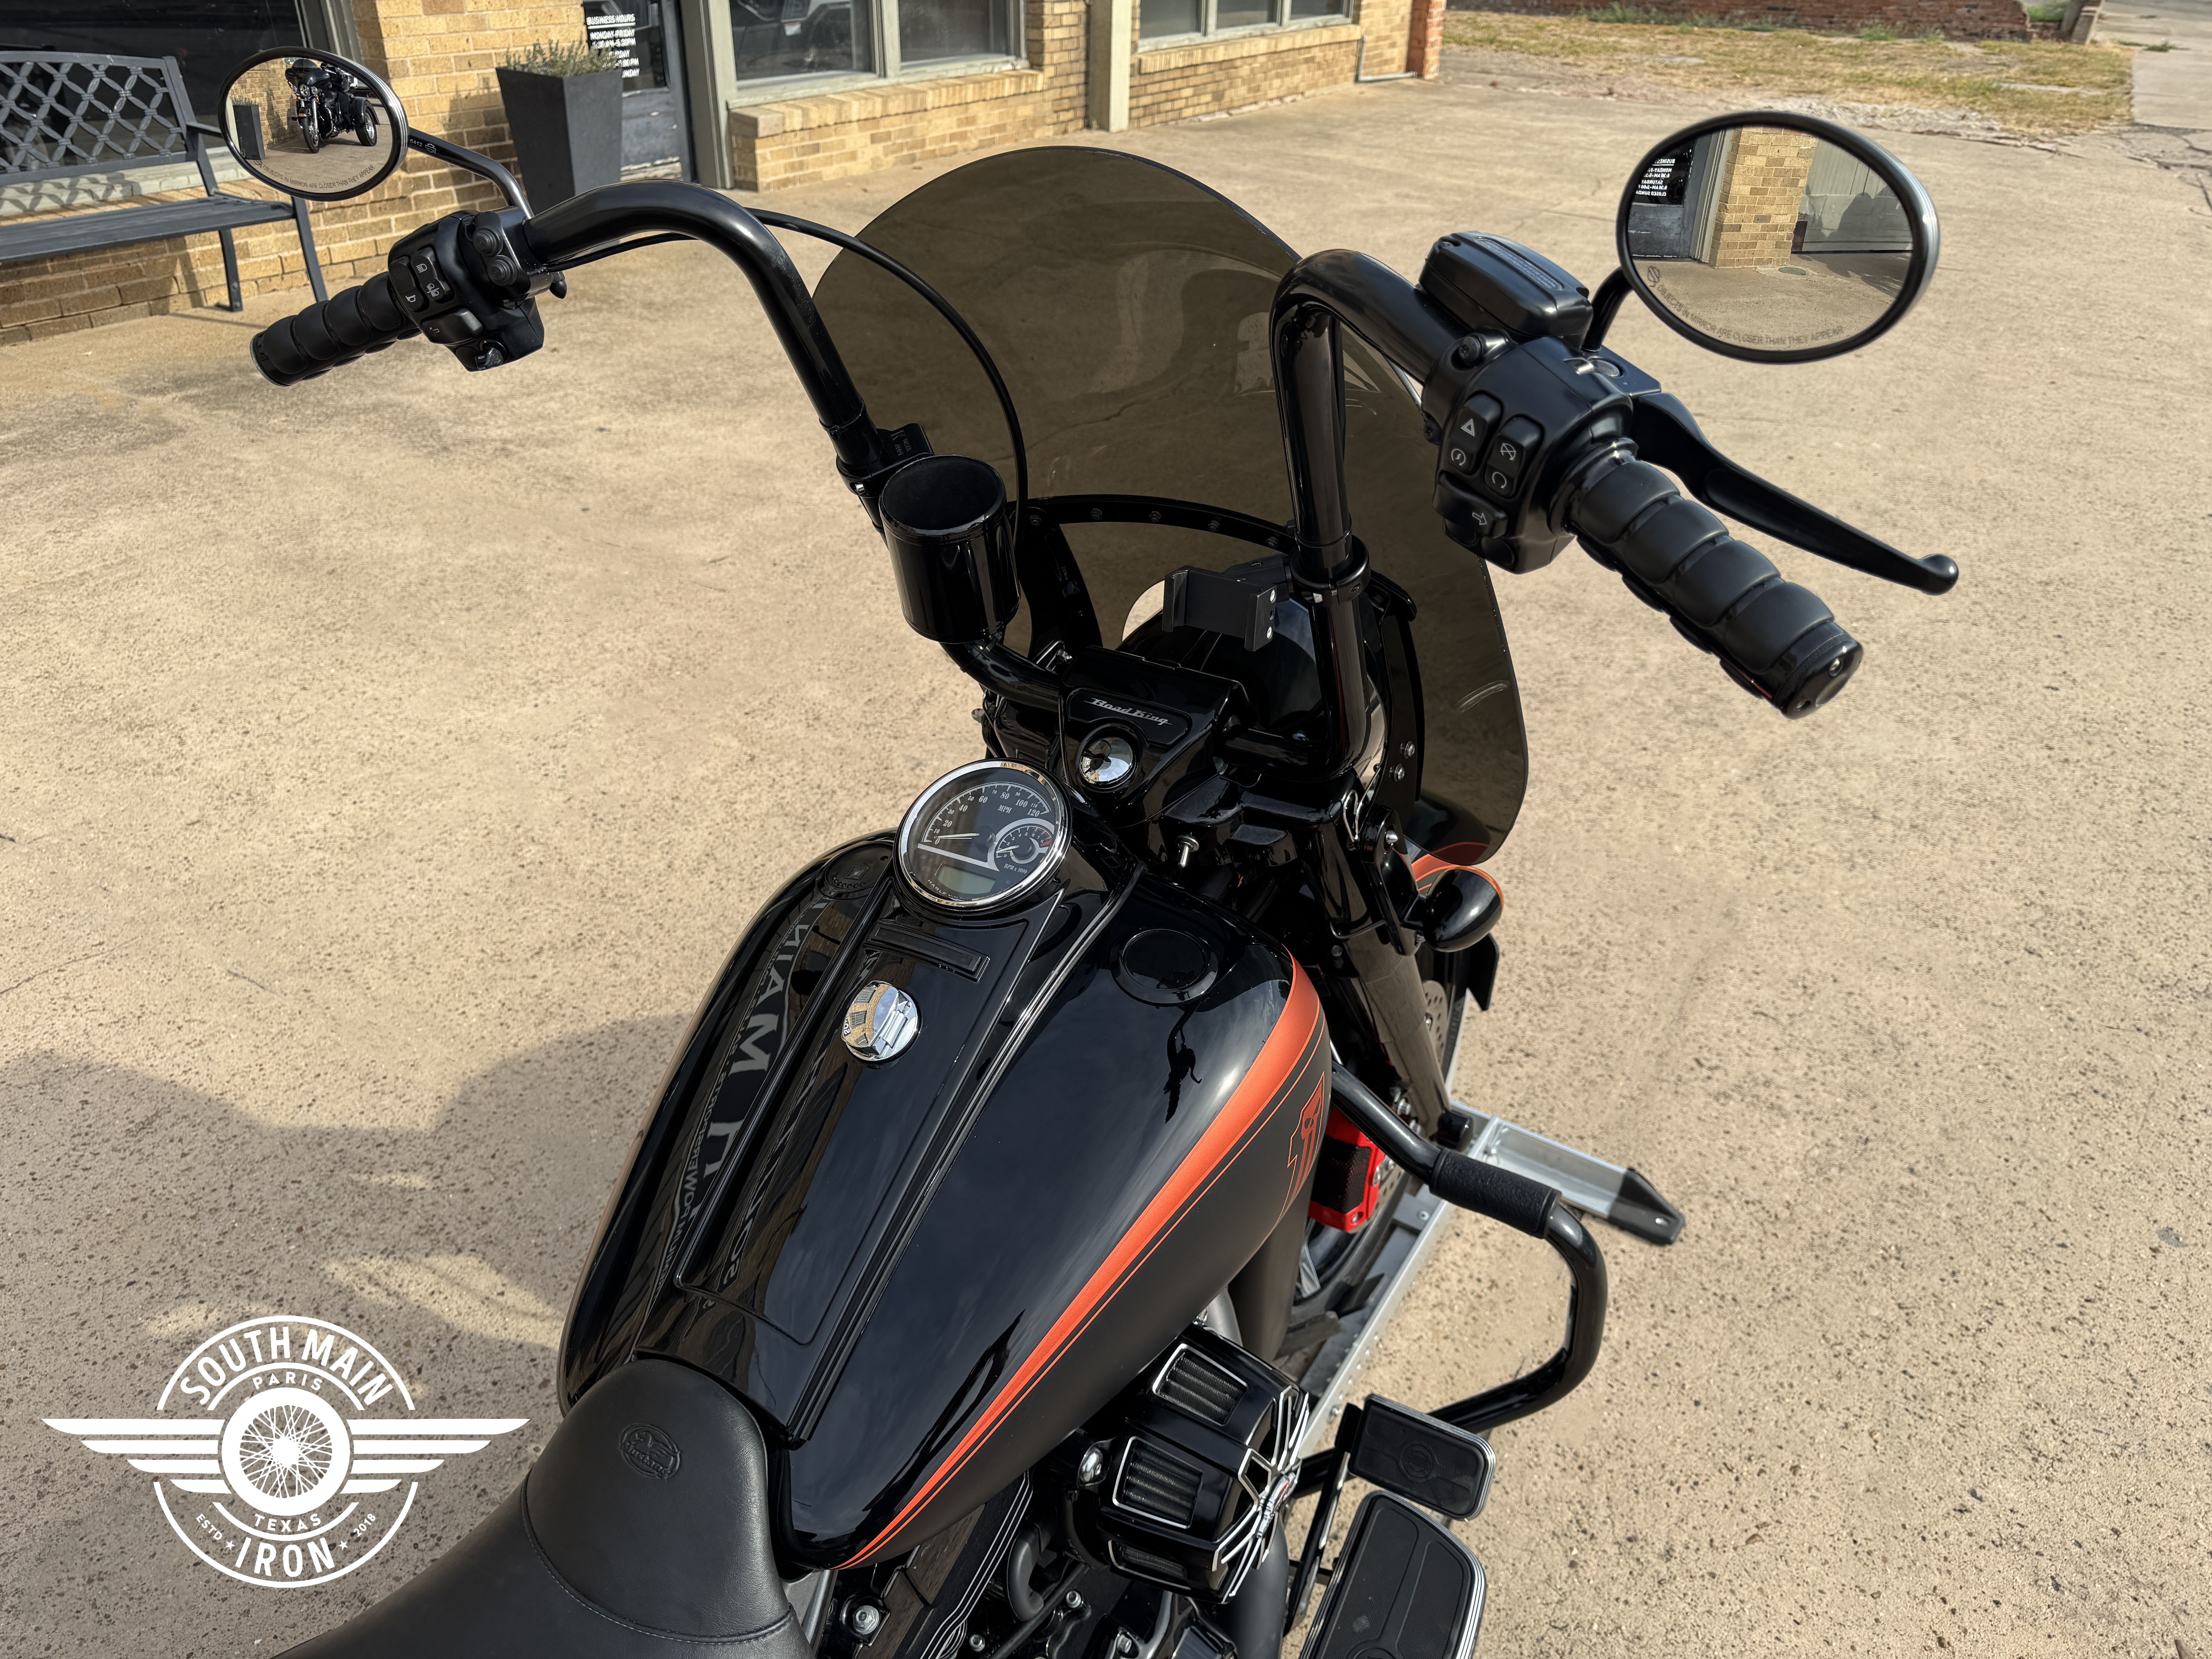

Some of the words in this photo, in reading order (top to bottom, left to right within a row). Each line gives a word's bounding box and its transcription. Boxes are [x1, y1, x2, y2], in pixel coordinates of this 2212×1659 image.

[586, 15, 615, 25] BUSINESS
[615, 14, 635, 23] HOURS
[410, 139, 422, 148] 5412
[263, 165, 283, 179] OBJECTS
[290, 179, 308, 188] MIRROR
[348, 175, 359, 183] THEY
[359, 165, 375, 178] APPEAR
[1657, 284, 1683, 312] OBJECTS
[1681, 309, 1690, 318] IN
[1689, 313, 1717, 333] MIRROR
[1716, 327, 1732, 338] ARE
[1084, 697, 1135, 714] Road
[1133, 709, 1173, 725] King
[1015, 799, 1028, 807] 100
[998, 805, 1012, 814] MPH
[1027, 809, 1040, 817] 120
[943, 819, 953, 828] 20
